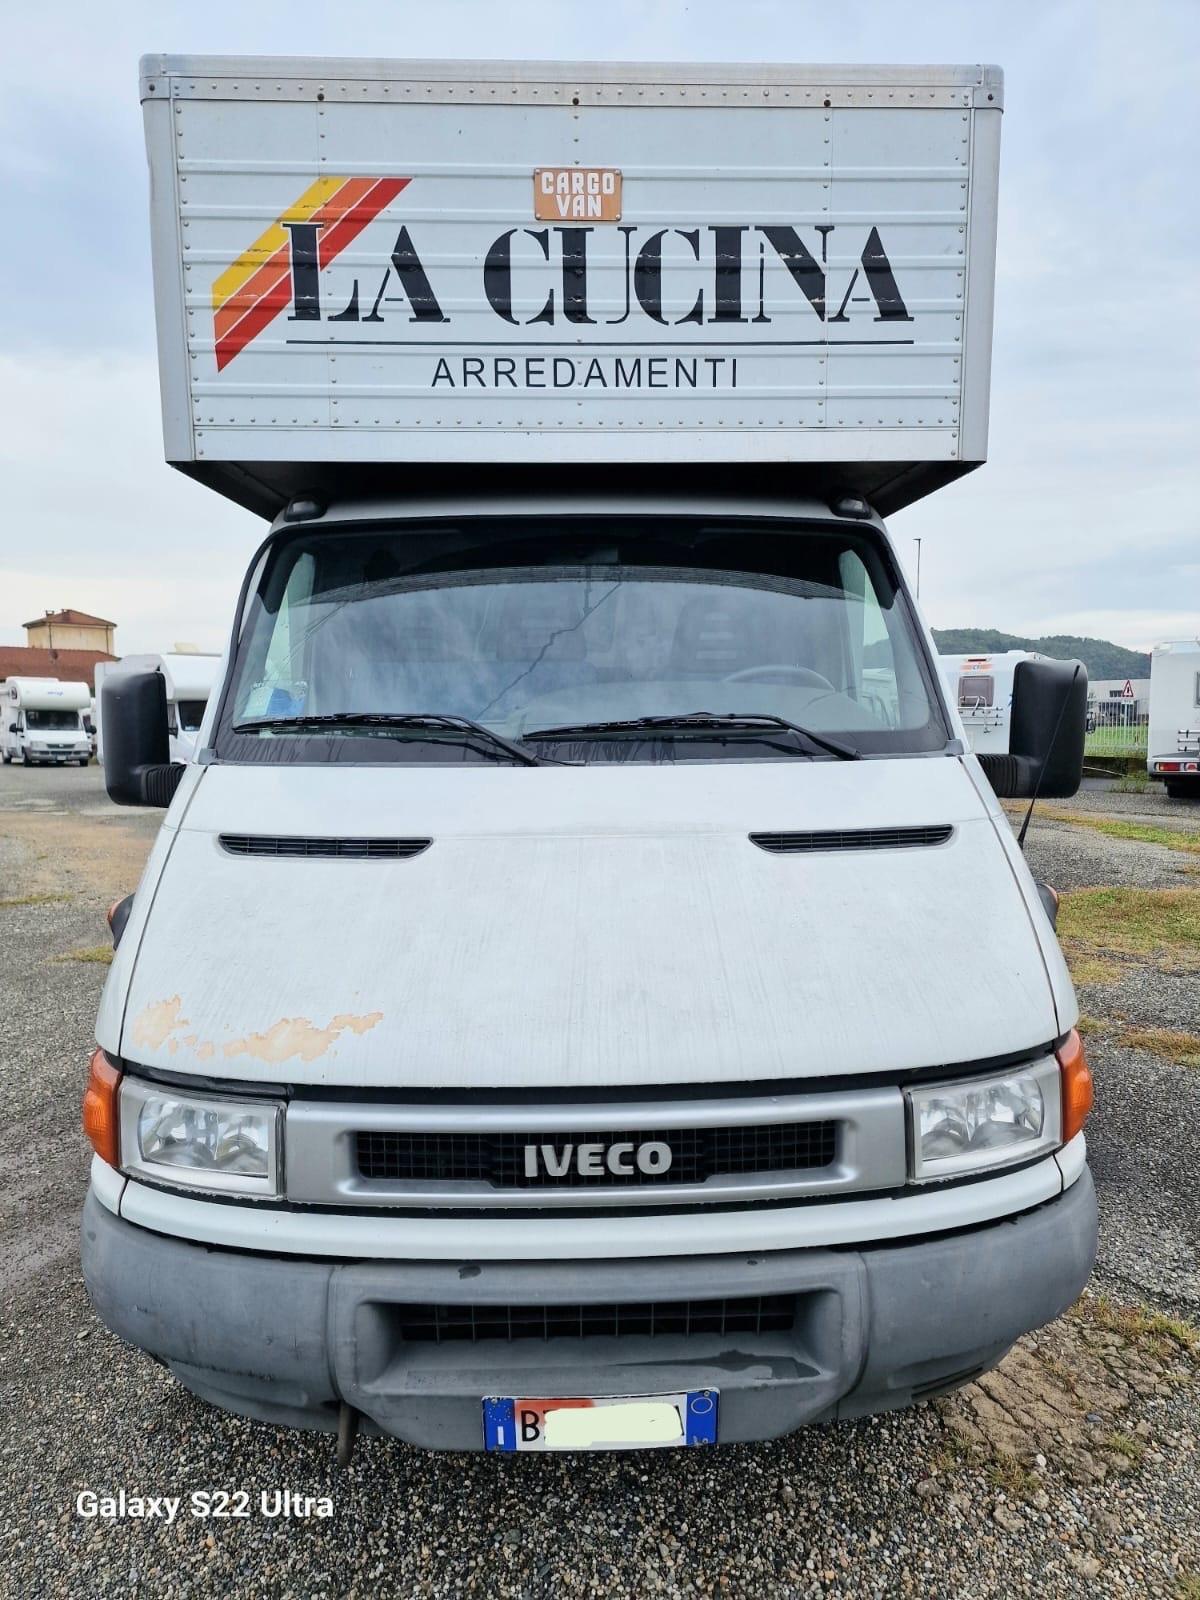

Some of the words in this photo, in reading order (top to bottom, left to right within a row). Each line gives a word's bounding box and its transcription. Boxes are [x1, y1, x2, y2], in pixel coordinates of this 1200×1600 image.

[541, 171, 615, 194] CARGO
[556, 194, 602, 217] VAN
[282, 223, 451, 323] LA
[483, 224, 914, 325] CUCINA
[432, 357, 737, 388] ARREDAMENTI
[524, 1141, 673, 1177] IVECO
